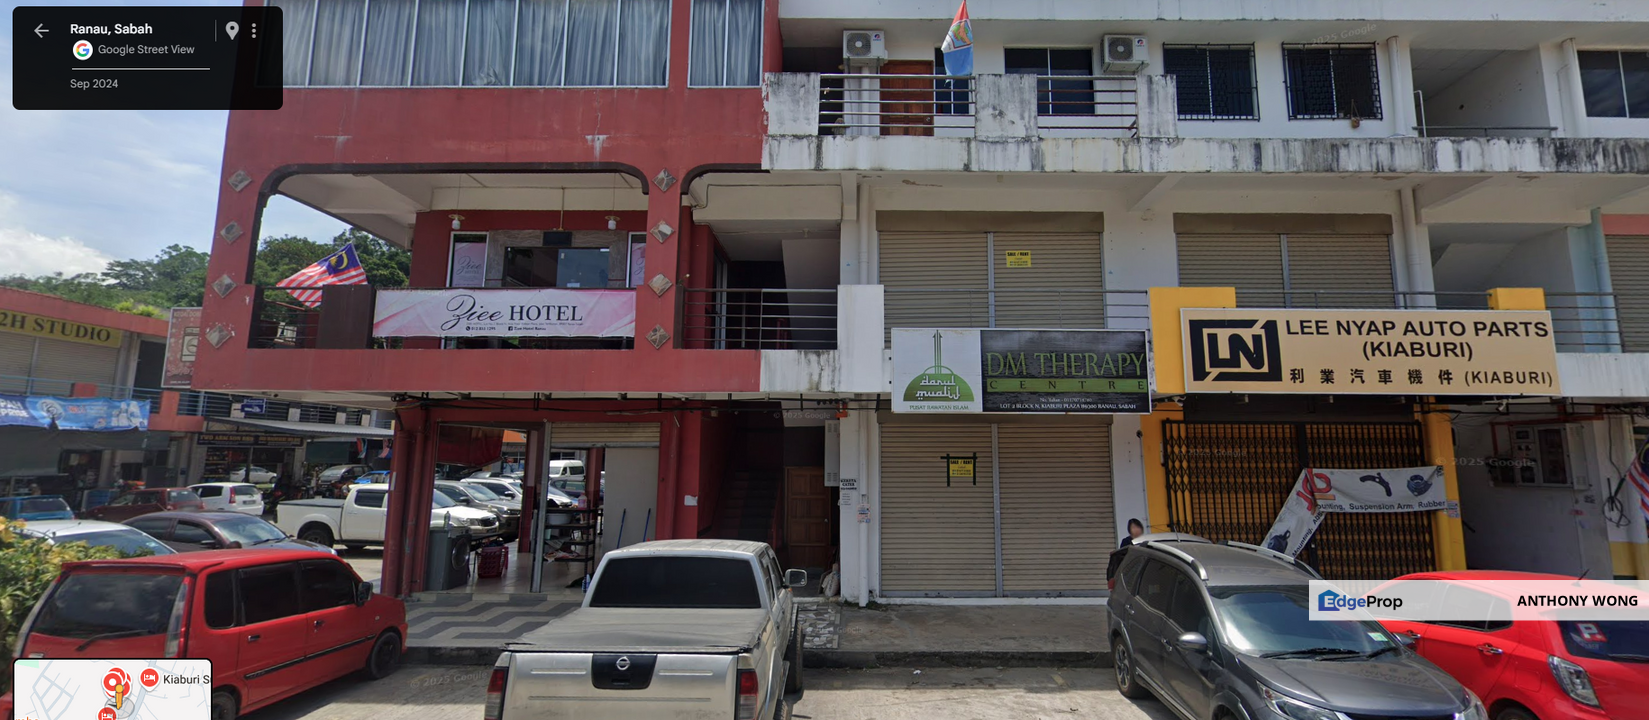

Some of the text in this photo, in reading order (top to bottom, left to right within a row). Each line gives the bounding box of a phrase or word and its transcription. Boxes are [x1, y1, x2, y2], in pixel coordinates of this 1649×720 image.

[440, 294, 584, 332] Ziee HOTEL
[33, 317, 110, 342] STUDIO
[1286, 320, 1548, 338] LEE NYAP AUTO PARTS
[1363, 341, 1472, 362] (KIABURI)
[986, 352, 1144, 376] DM THERAPY
[920, 375, 956, 386] darul
[990, 380, 1144, 390] CENTRE
[1464, 371, 1553, 388] (KIABURI)
[916, 386, 960, 400] mualij
[1316, 503, 1345, 511] ounting,
[1349, 503, 1395, 511] Suspension
[1418, 500, 1446, 509] Rubber
